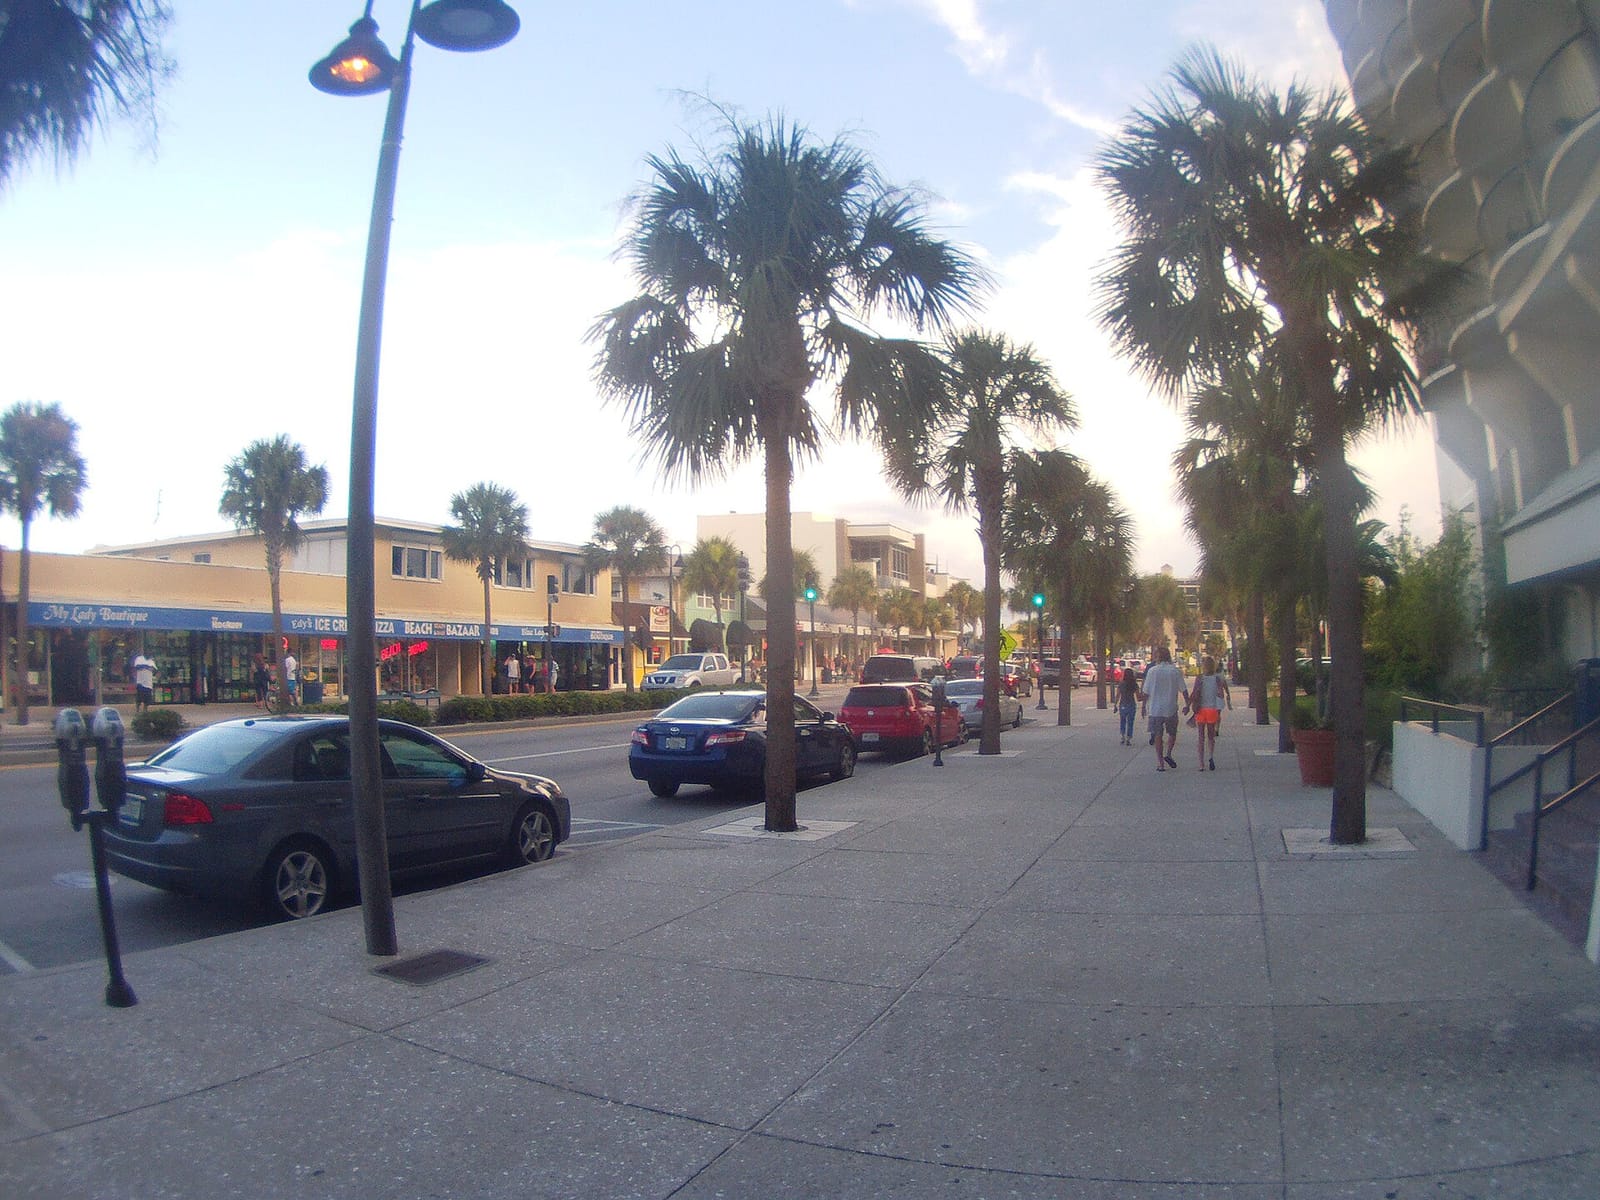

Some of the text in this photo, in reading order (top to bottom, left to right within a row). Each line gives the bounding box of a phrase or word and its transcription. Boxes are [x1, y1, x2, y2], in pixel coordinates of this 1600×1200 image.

[43, 605, 148, 625] My Lady Boutique
[315, 618, 331, 631] ICE
[374, 621, 395, 634] IZZA
[404, 621, 433, 635] BEACH
[446, 624, 480, 636] BAZAAR
